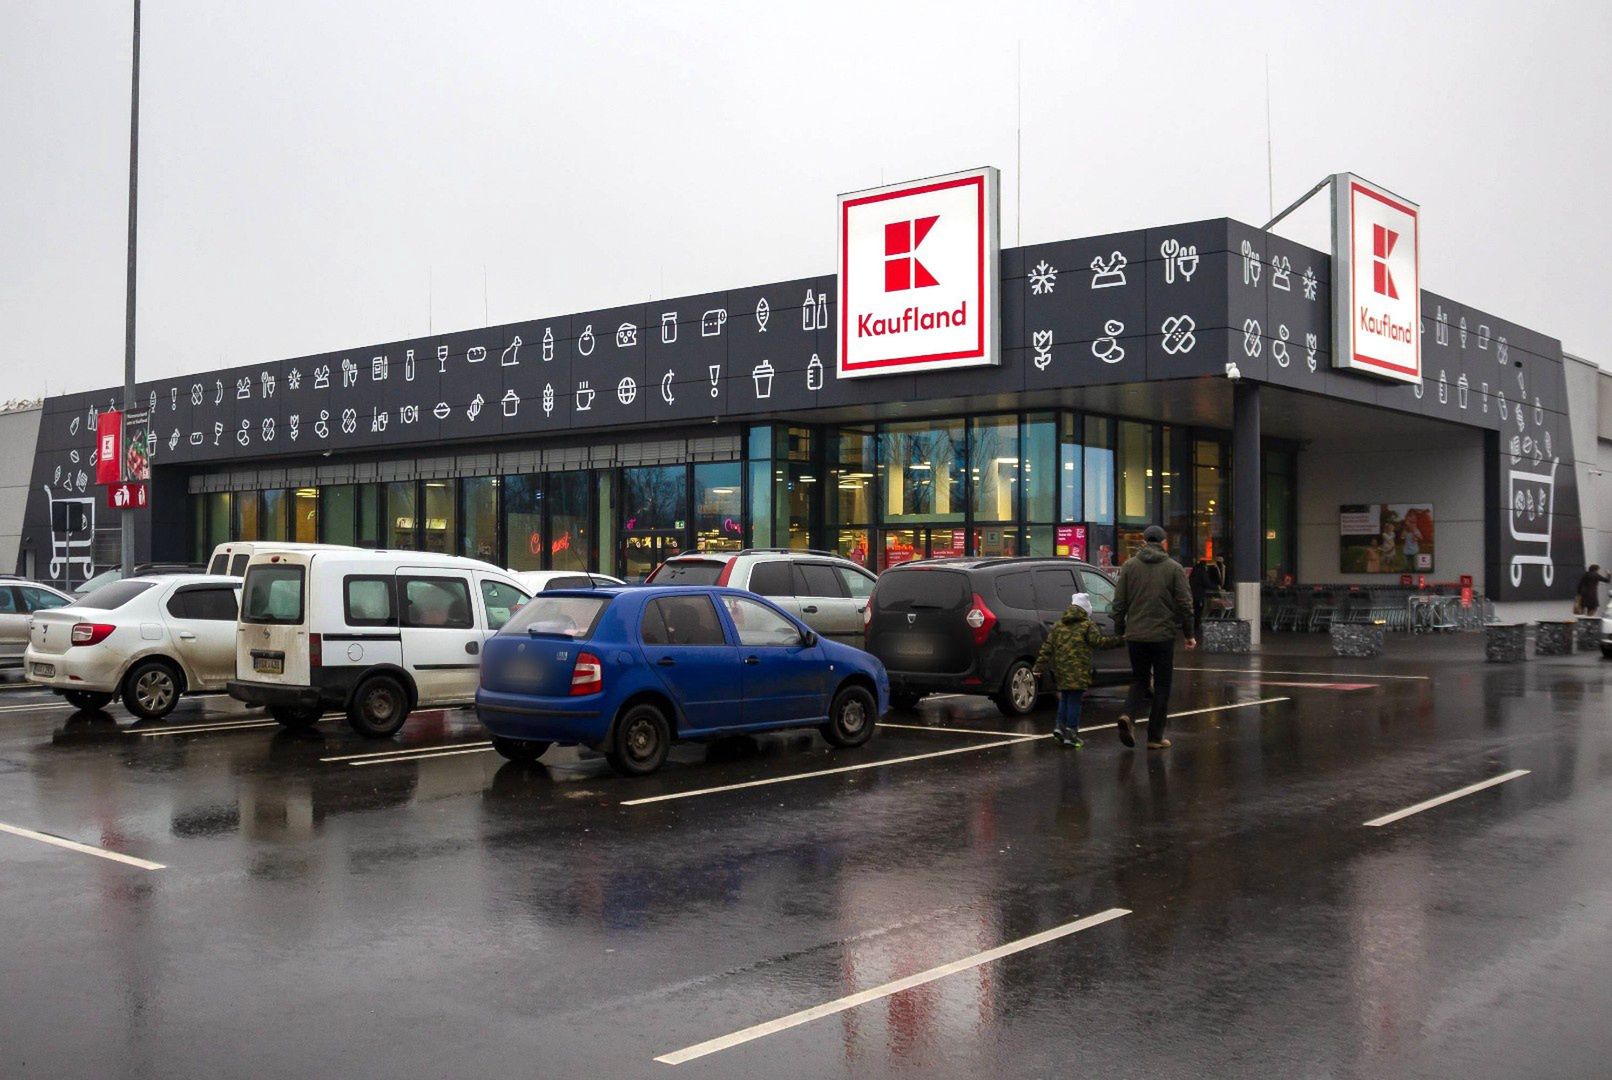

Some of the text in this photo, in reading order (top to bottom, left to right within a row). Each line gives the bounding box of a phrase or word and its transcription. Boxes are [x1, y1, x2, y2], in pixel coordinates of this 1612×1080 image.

[885, 215, 940, 292] K
[1373, 223, 1399, 300] K
[858, 301, 967, 338] Kaufland
[1361, 305, 1412, 344] Kaufland
